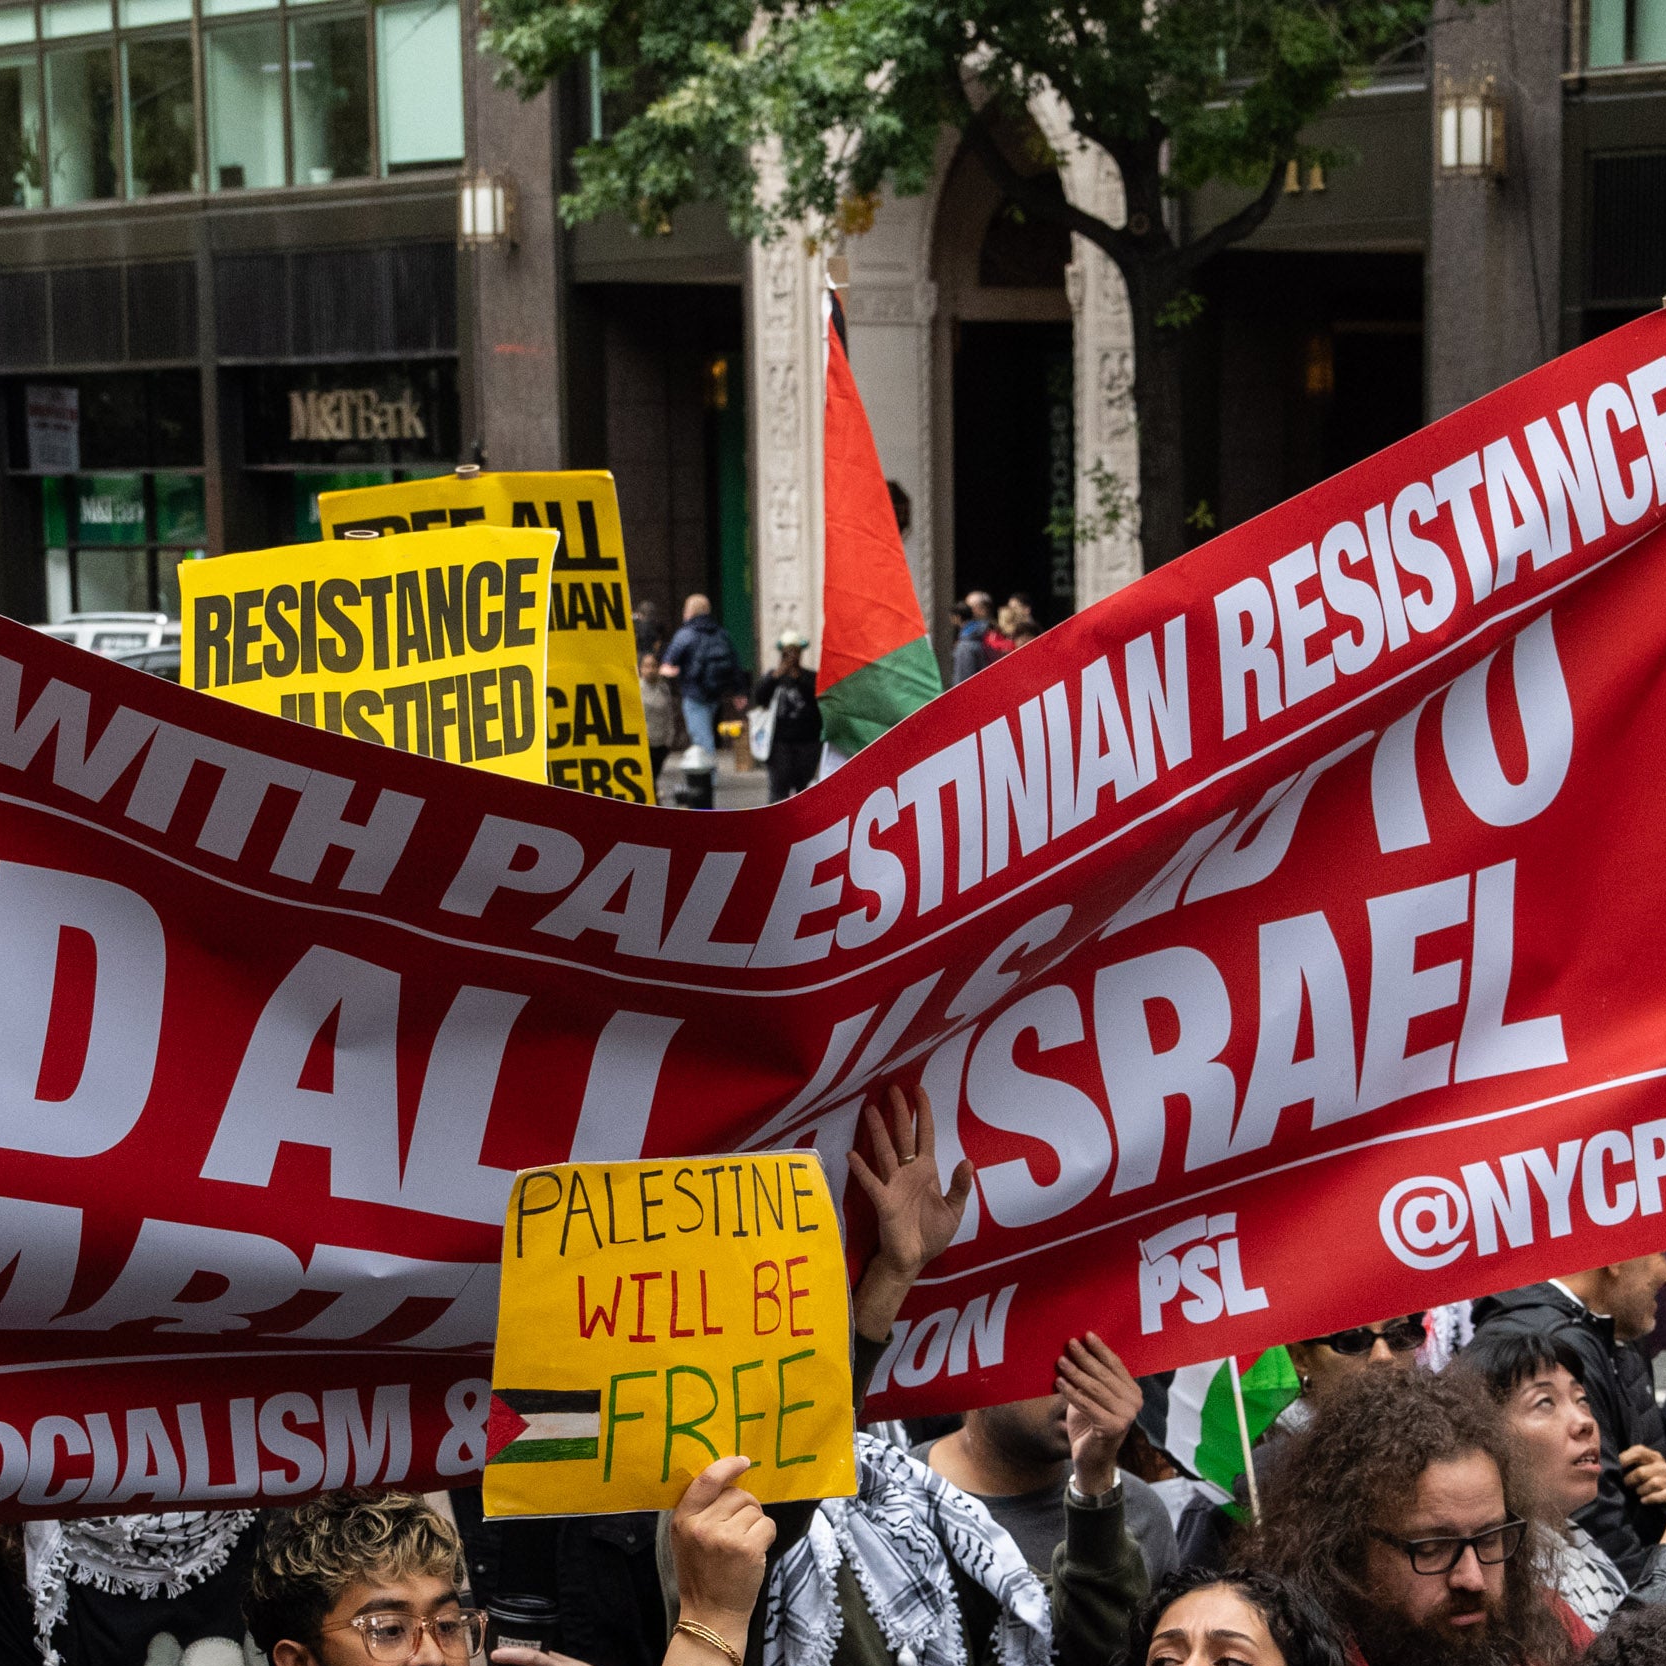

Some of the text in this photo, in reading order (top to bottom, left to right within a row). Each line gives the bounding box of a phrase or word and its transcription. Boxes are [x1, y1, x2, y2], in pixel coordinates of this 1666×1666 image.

[358, 387, 427, 441] Bank
[193, 557, 539, 690] RESISTANCE
[548, 582, 627, 631] IAN
[437, 613, 1193, 970] PALESTINIAN
[547, 757, 650, 806] ERS
[515, 1162, 820, 1258] PALESTINE
[578, 1256, 815, 1343] WILL BE
[435, 1377, 491, 1478] &
[603, 1349, 817, 1483] FREE
